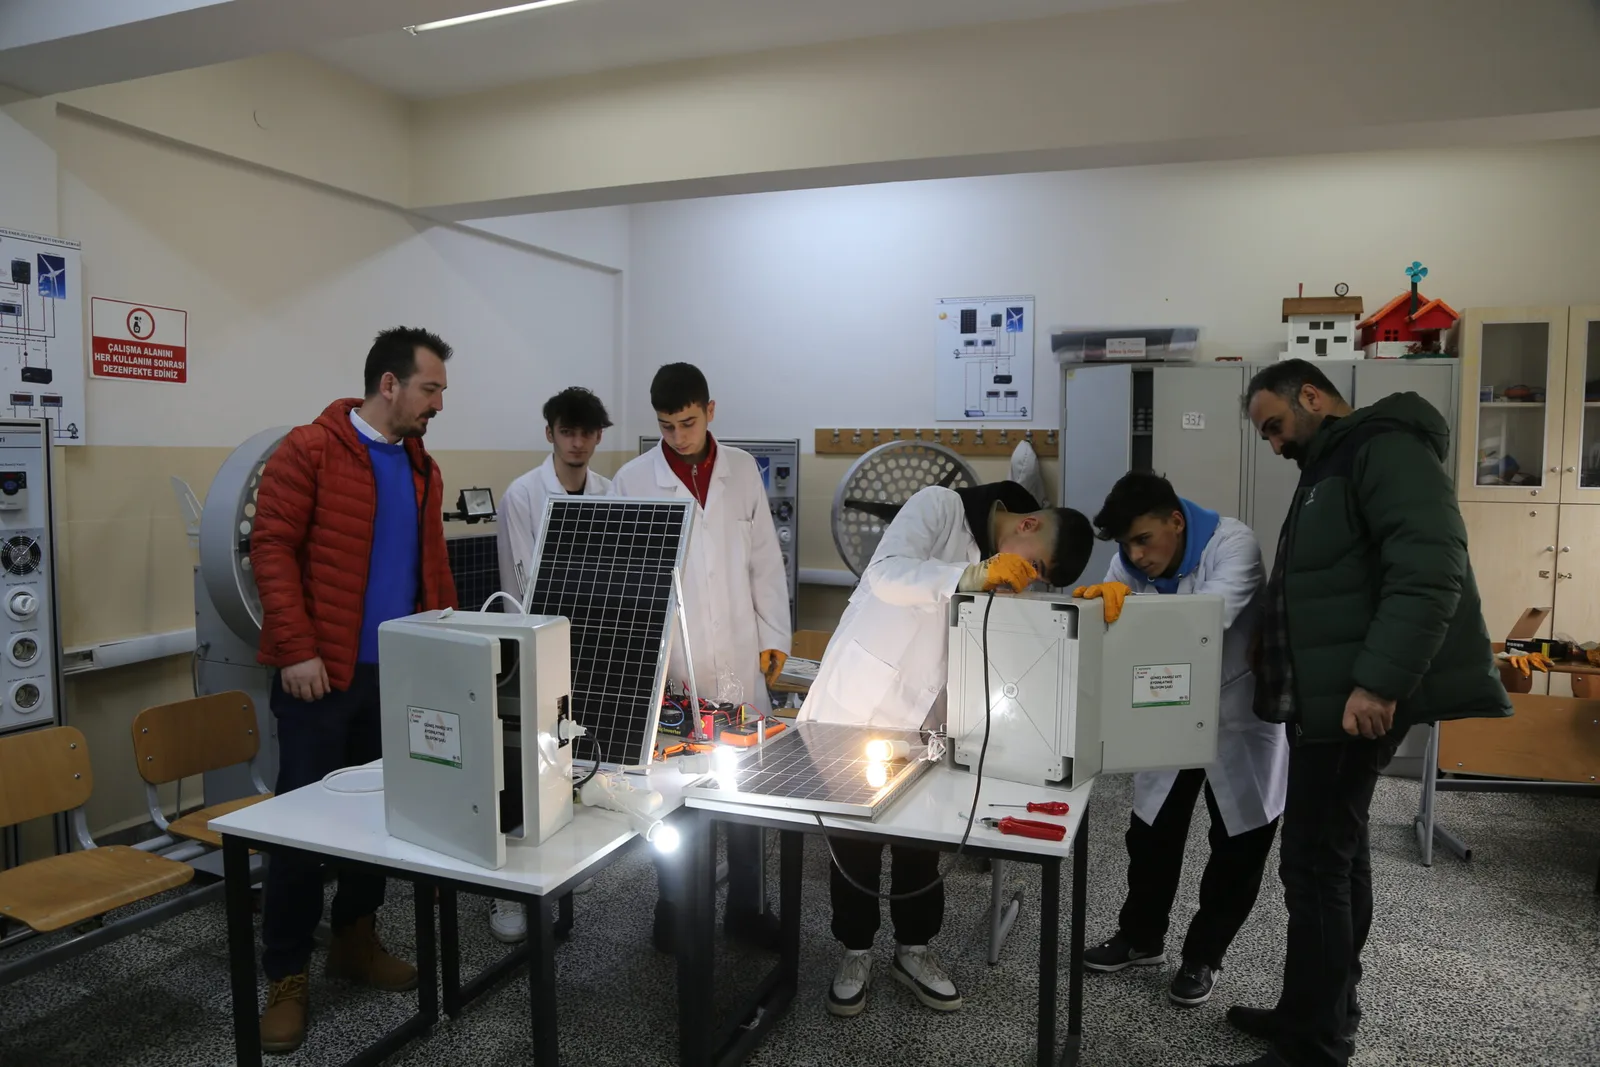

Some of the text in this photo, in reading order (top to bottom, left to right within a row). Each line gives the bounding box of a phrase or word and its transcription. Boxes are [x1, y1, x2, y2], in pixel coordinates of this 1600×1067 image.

[108, 343, 173, 358] ÇALIŞMA ALANINI
[94, 353, 185, 369] HER KULLANIM SONRASI
[103, 365, 178, 379] DEZENFEKTE EDİNİZ
